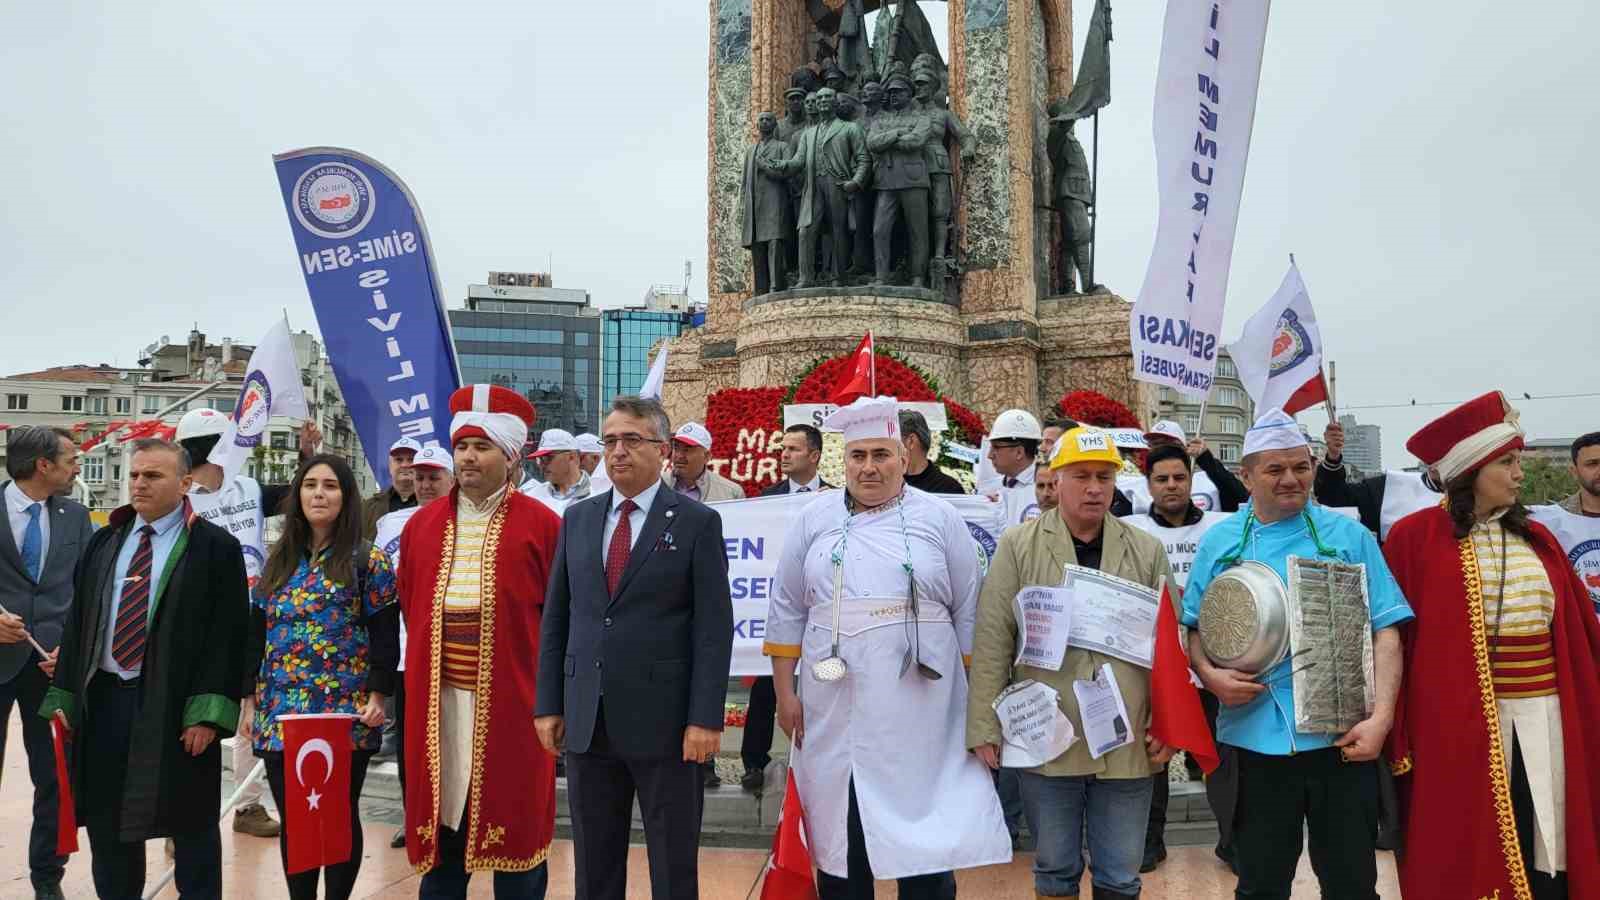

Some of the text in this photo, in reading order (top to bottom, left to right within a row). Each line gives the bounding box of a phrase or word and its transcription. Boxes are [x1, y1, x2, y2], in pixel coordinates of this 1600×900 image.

[1081, 436, 1104, 446] YHS
[706, 453, 788, 483] TÜR
[1176, 540, 1197, 553] MÜC
